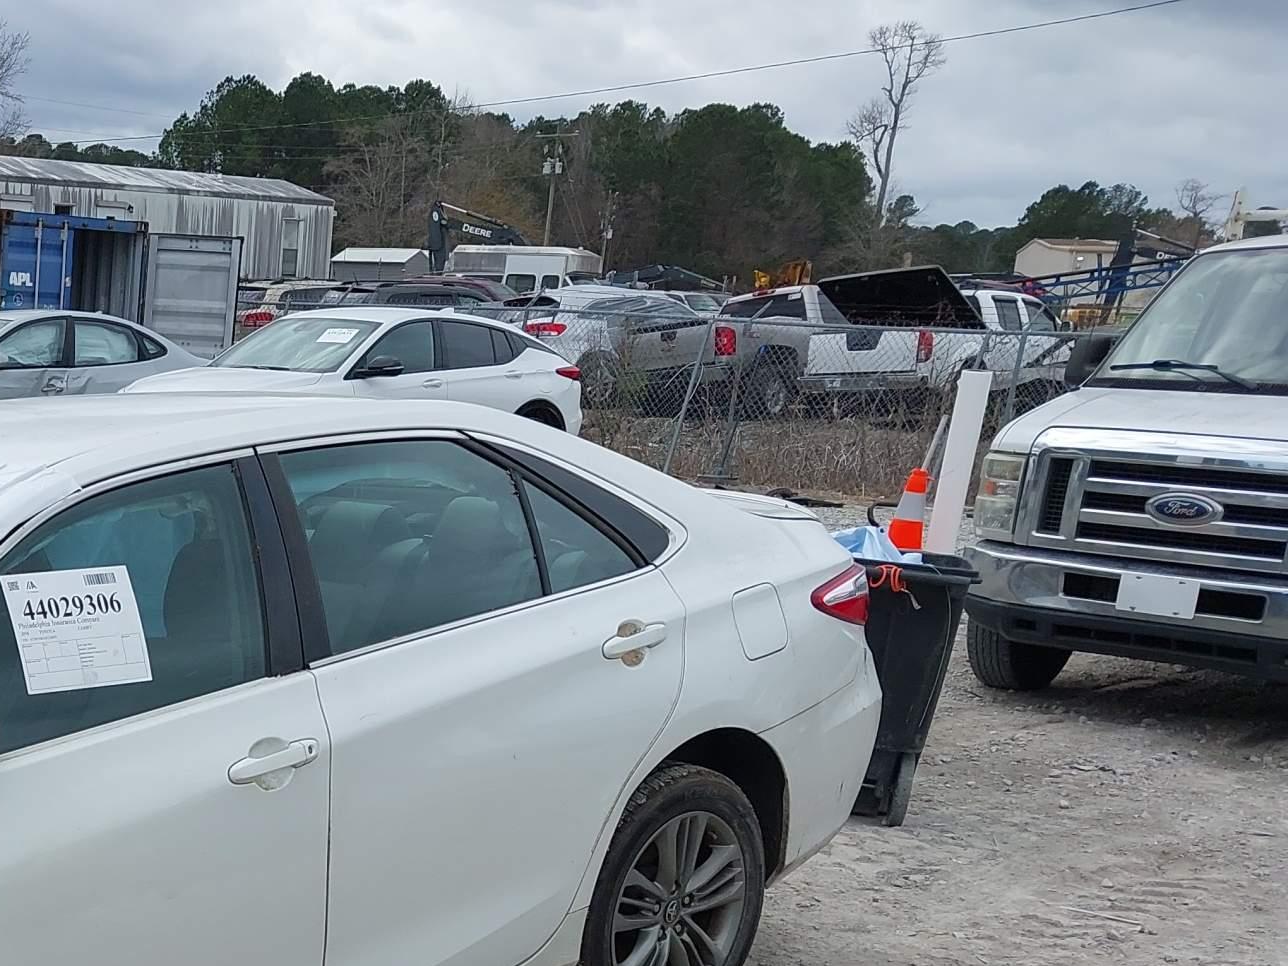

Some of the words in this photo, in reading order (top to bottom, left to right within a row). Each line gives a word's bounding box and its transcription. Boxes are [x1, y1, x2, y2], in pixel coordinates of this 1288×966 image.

[462, 223, 493, 238] DEERE
[9, 271, 33, 287] APL
[1164, 500, 1198, 516] Ford
[23, 592, 122, 620] 44029306
